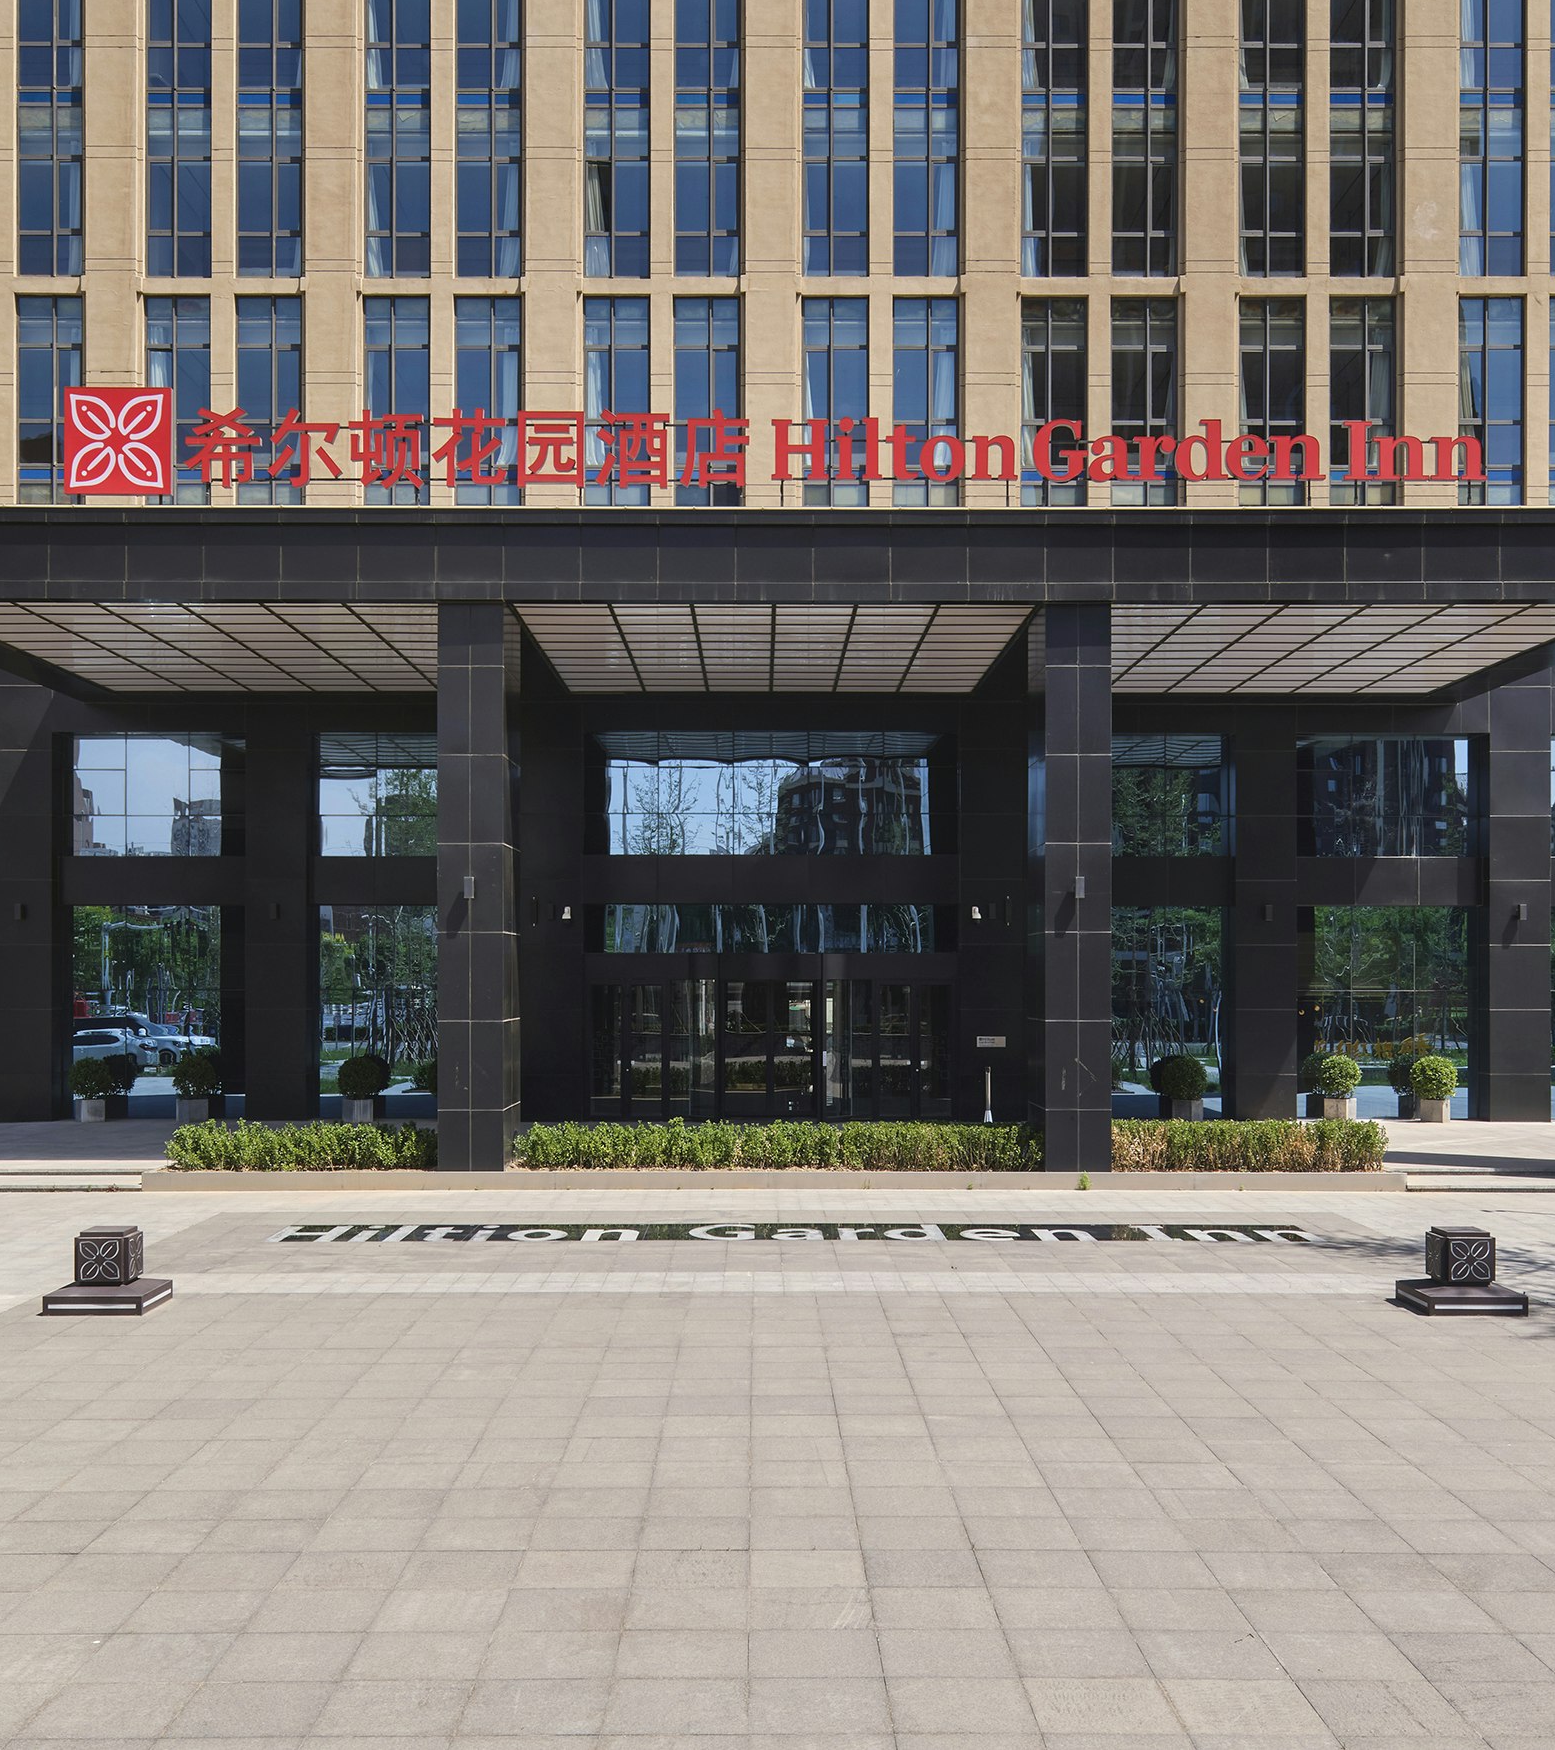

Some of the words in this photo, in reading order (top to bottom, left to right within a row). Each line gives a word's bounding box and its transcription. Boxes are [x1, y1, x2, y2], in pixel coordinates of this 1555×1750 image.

[184, 407, 750, 490] 希尔顿花园酒店
[771, 416, 1019, 483] Hilton
[1032, 418, 1326, 483] Garden
[1342, 420, 1488, 482] Inn
[688, 1223, 1099, 1242] Garden
[1130, 1224, 1328, 1243] Inn
